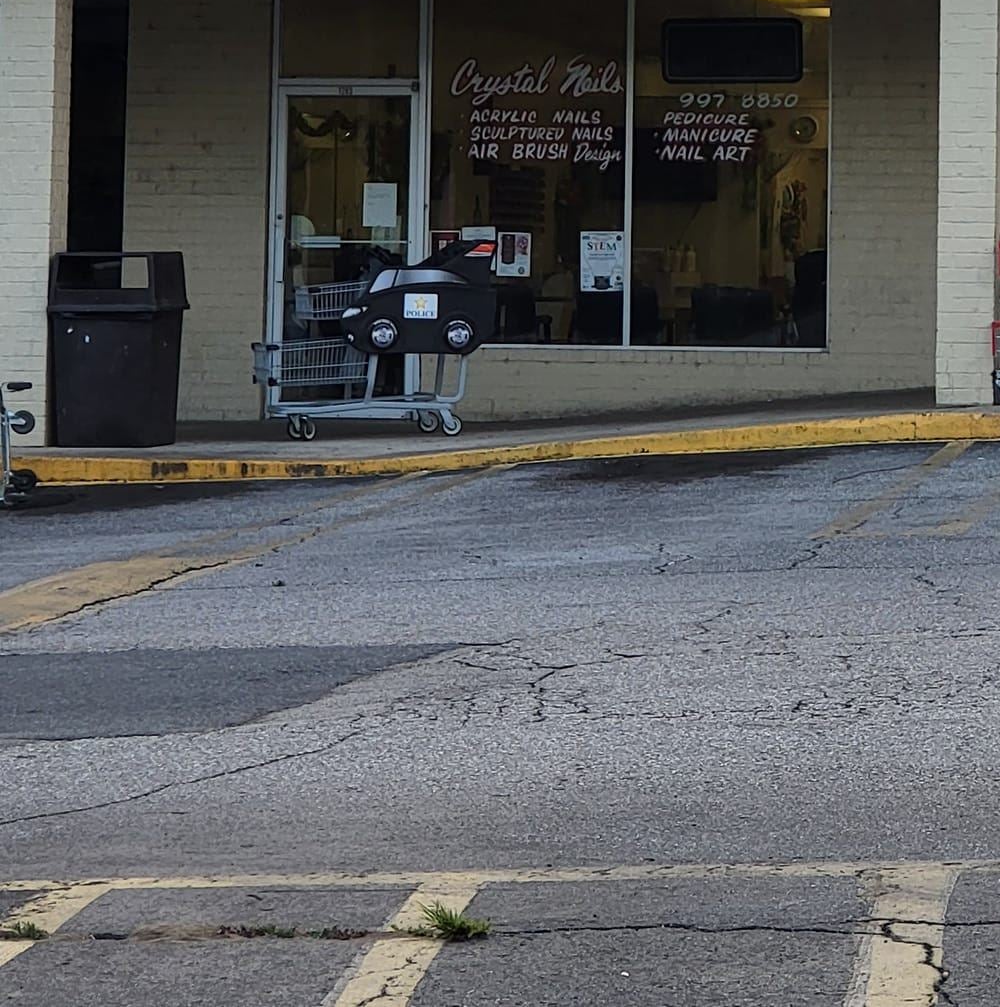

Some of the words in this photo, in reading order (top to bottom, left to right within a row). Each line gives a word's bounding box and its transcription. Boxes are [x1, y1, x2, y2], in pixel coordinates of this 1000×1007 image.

[451, 55, 556, 105] Crystal
[560, 54, 625, 97] Nails
[679, 92, 725, 108] 997
[741, 93, 799, 108] 8850
[470, 109, 537, 123] ACRYLIC
[552, 110, 601, 124] NAILS
[663, 111, 750, 126] PEDICURE
[470, 126, 565, 141] SCULPTURED
[571, 126, 614, 141] NAILS
[662, 128, 759, 144] MANICURE
[468, 142, 499, 160] AIR
[512, 143, 569, 160] BRUSH
[573, 142, 622, 170] Design
[660, 145, 705, 161] NAIL
[712, 145, 753, 162] ART
